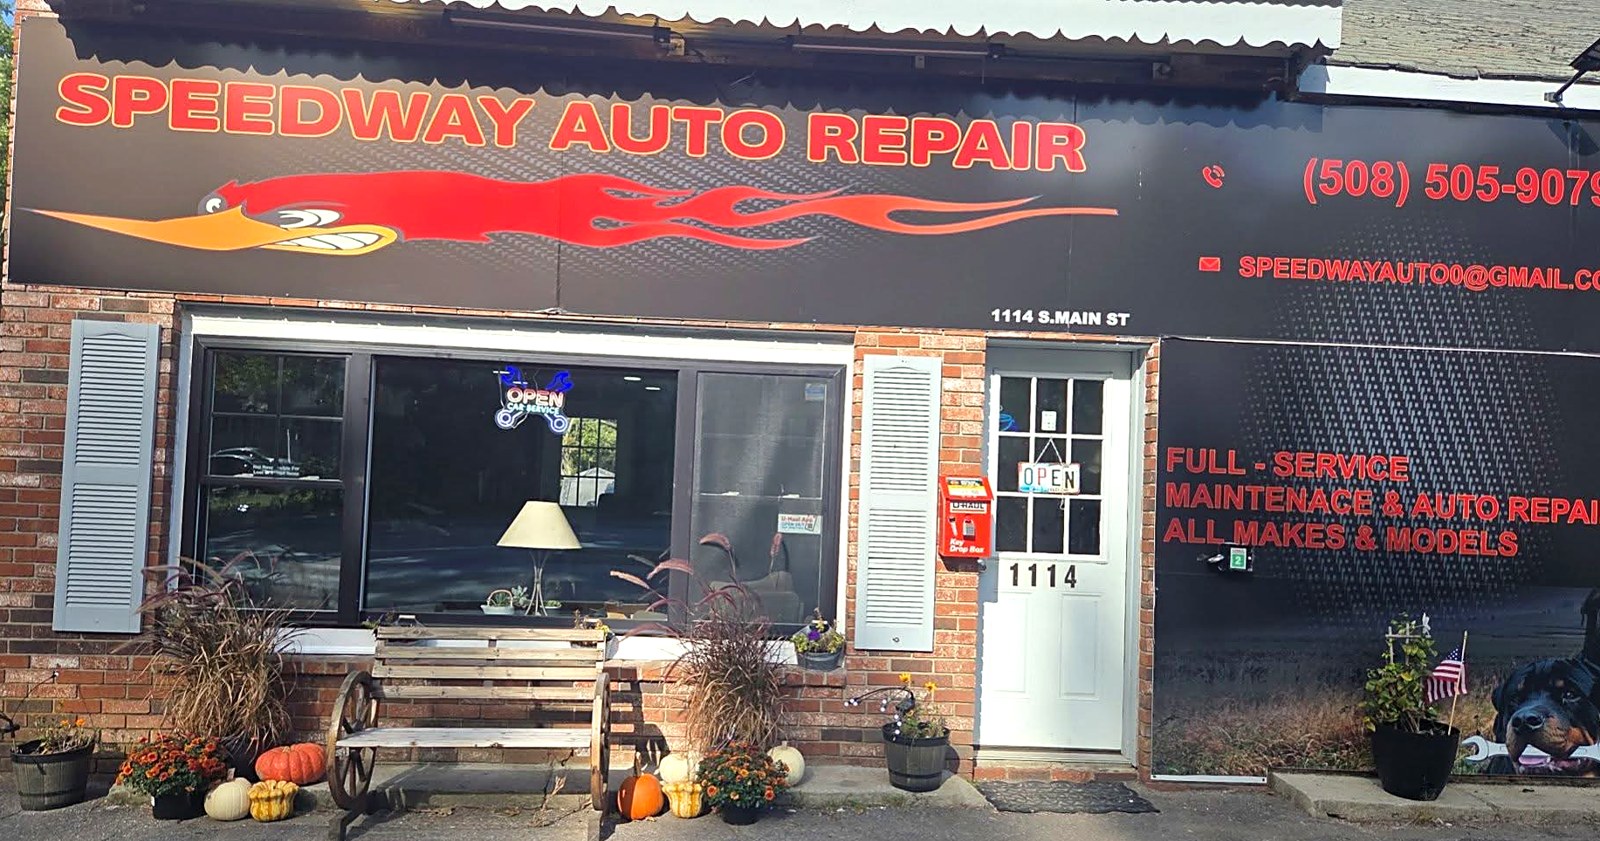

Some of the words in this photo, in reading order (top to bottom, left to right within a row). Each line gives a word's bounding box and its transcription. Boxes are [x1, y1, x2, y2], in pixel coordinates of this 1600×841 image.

[55, 72, 536, 149] SPEEDWAY
[548, 101, 786, 161] AUTO
[807, 112, 1086, 172] REPAIR
[1303, 158, 1411, 207] (508)
[991, 309, 1034, 323] 1114
[1038, 310, 1102, 326] S.MAIN
[1106, 313, 1131, 326] ST
[507, 387, 564, 407] OPEN
[507, 402, 526, 411] CAR
[526, 404, 560, 415] SERVICE
[1166, 447, 1245, 475] FULL
[1274, 451, 1409, 482] SERVICE
[1024, 467, 1075, 489] OPEN
[1165, 482, 1373, 515] MAINTENACE
[1382, 491, 1404, 517] &
[1411, 493, 1500, 521] AUTO
[1508, 496, 1600, 525] REPAI
[949, 538, 964, 547] Key
[1163, 518, 1224, 545] ALL
[1234, 521, 1346, 550] MAKES
[1355, 526, 1376, 551] &
[1386, 526, 1519, 557] MODELS
[949, 545, 968, 554] Drop
[1235, 556, 1242, 565] 2
[1010, 562, 1077, 588] 1114
